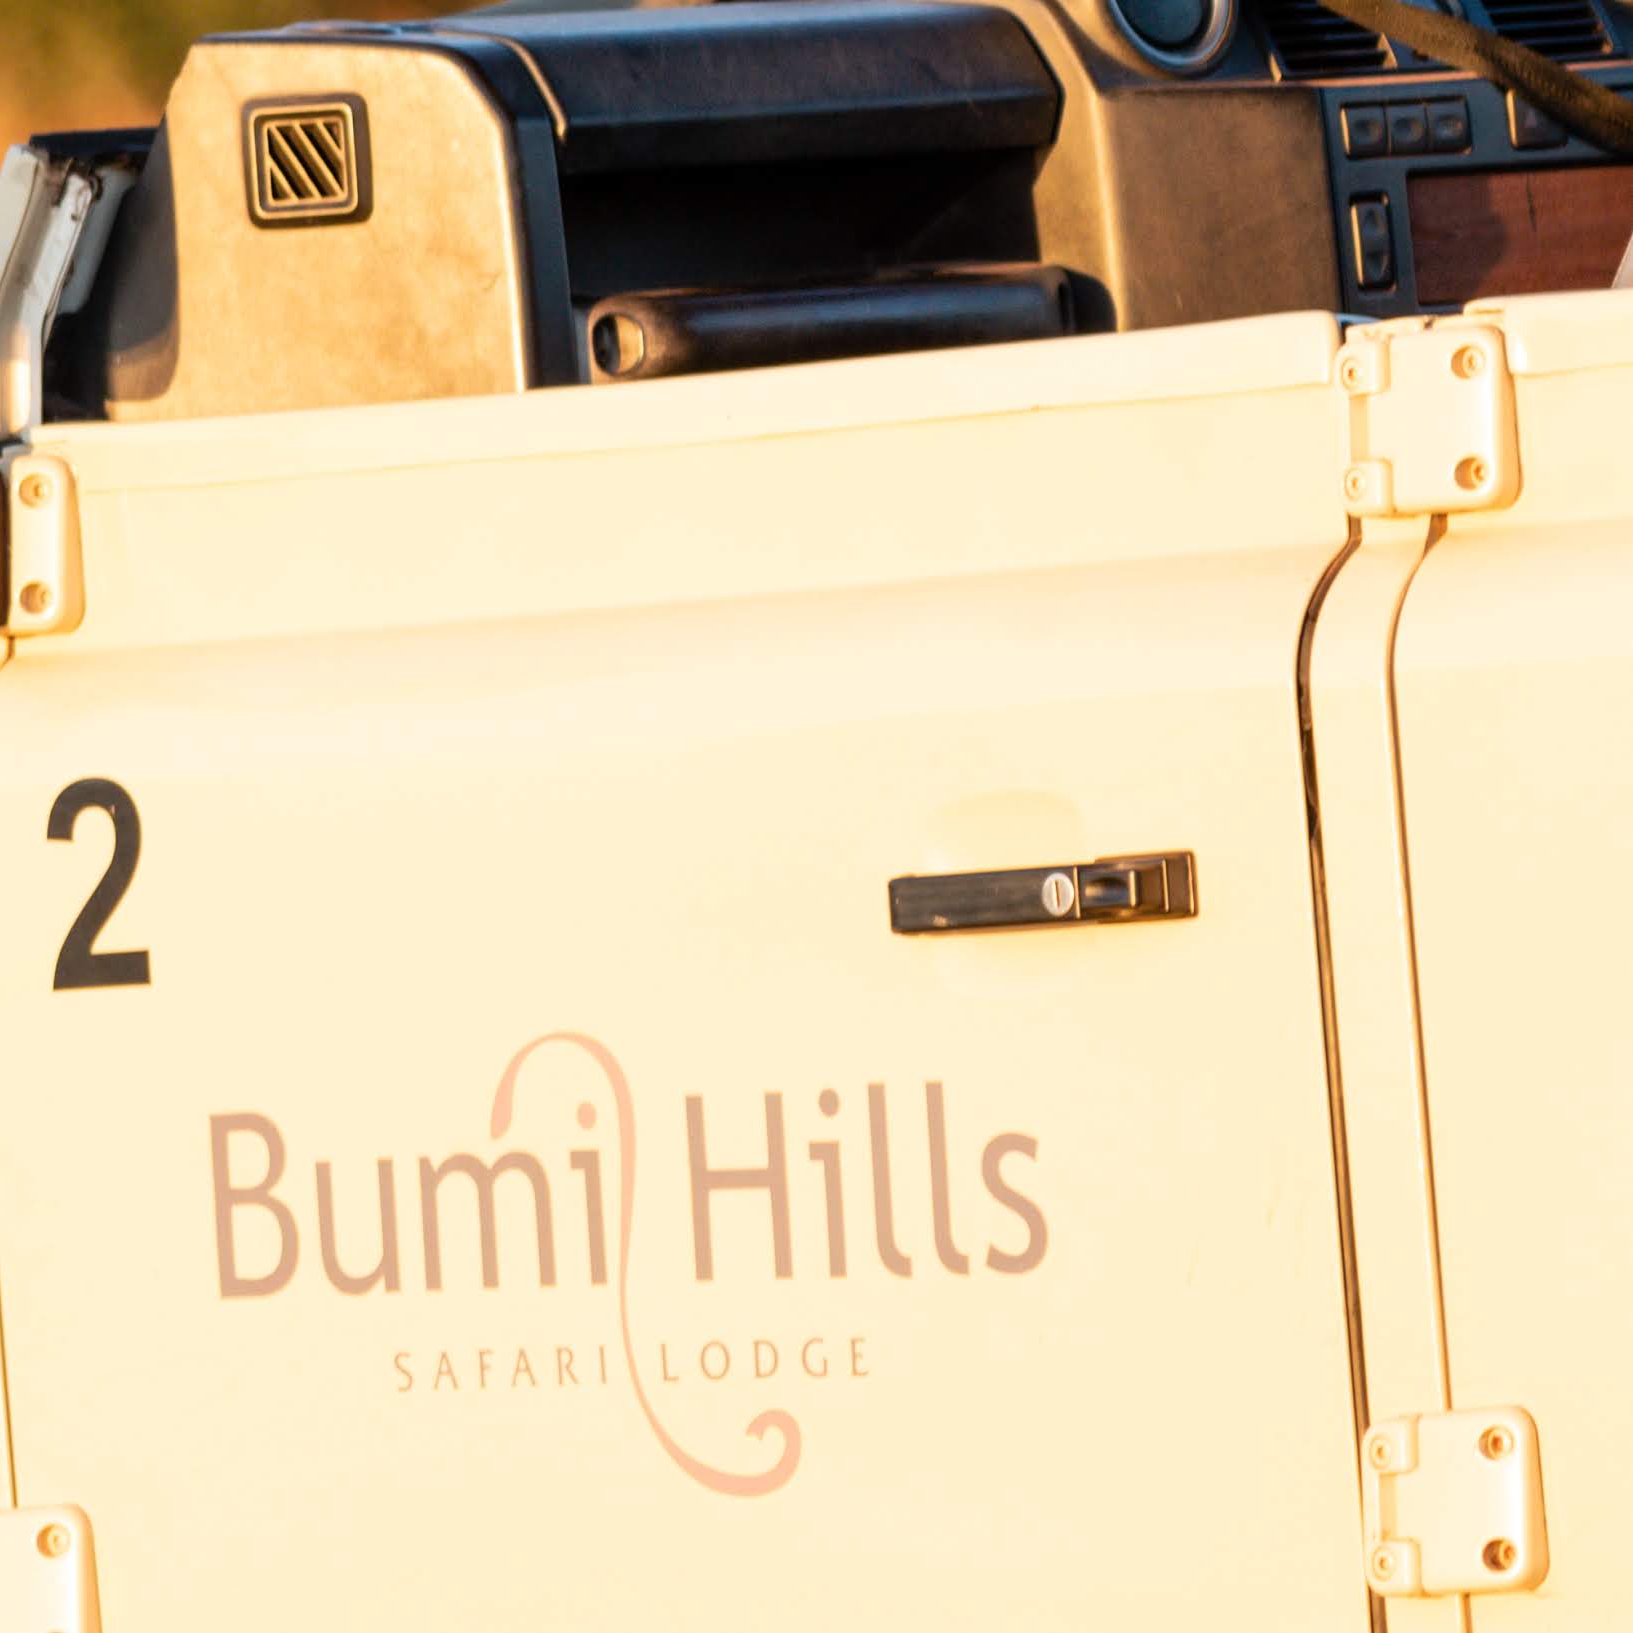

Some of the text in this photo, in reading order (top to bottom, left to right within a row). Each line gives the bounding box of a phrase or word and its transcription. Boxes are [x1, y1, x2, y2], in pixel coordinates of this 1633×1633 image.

[46, 776, 152, 992] 2
[207, 1080, 1049, 1300] Bumi Hills
[393, 1337, 869, 1392] SAFARI LODGE
